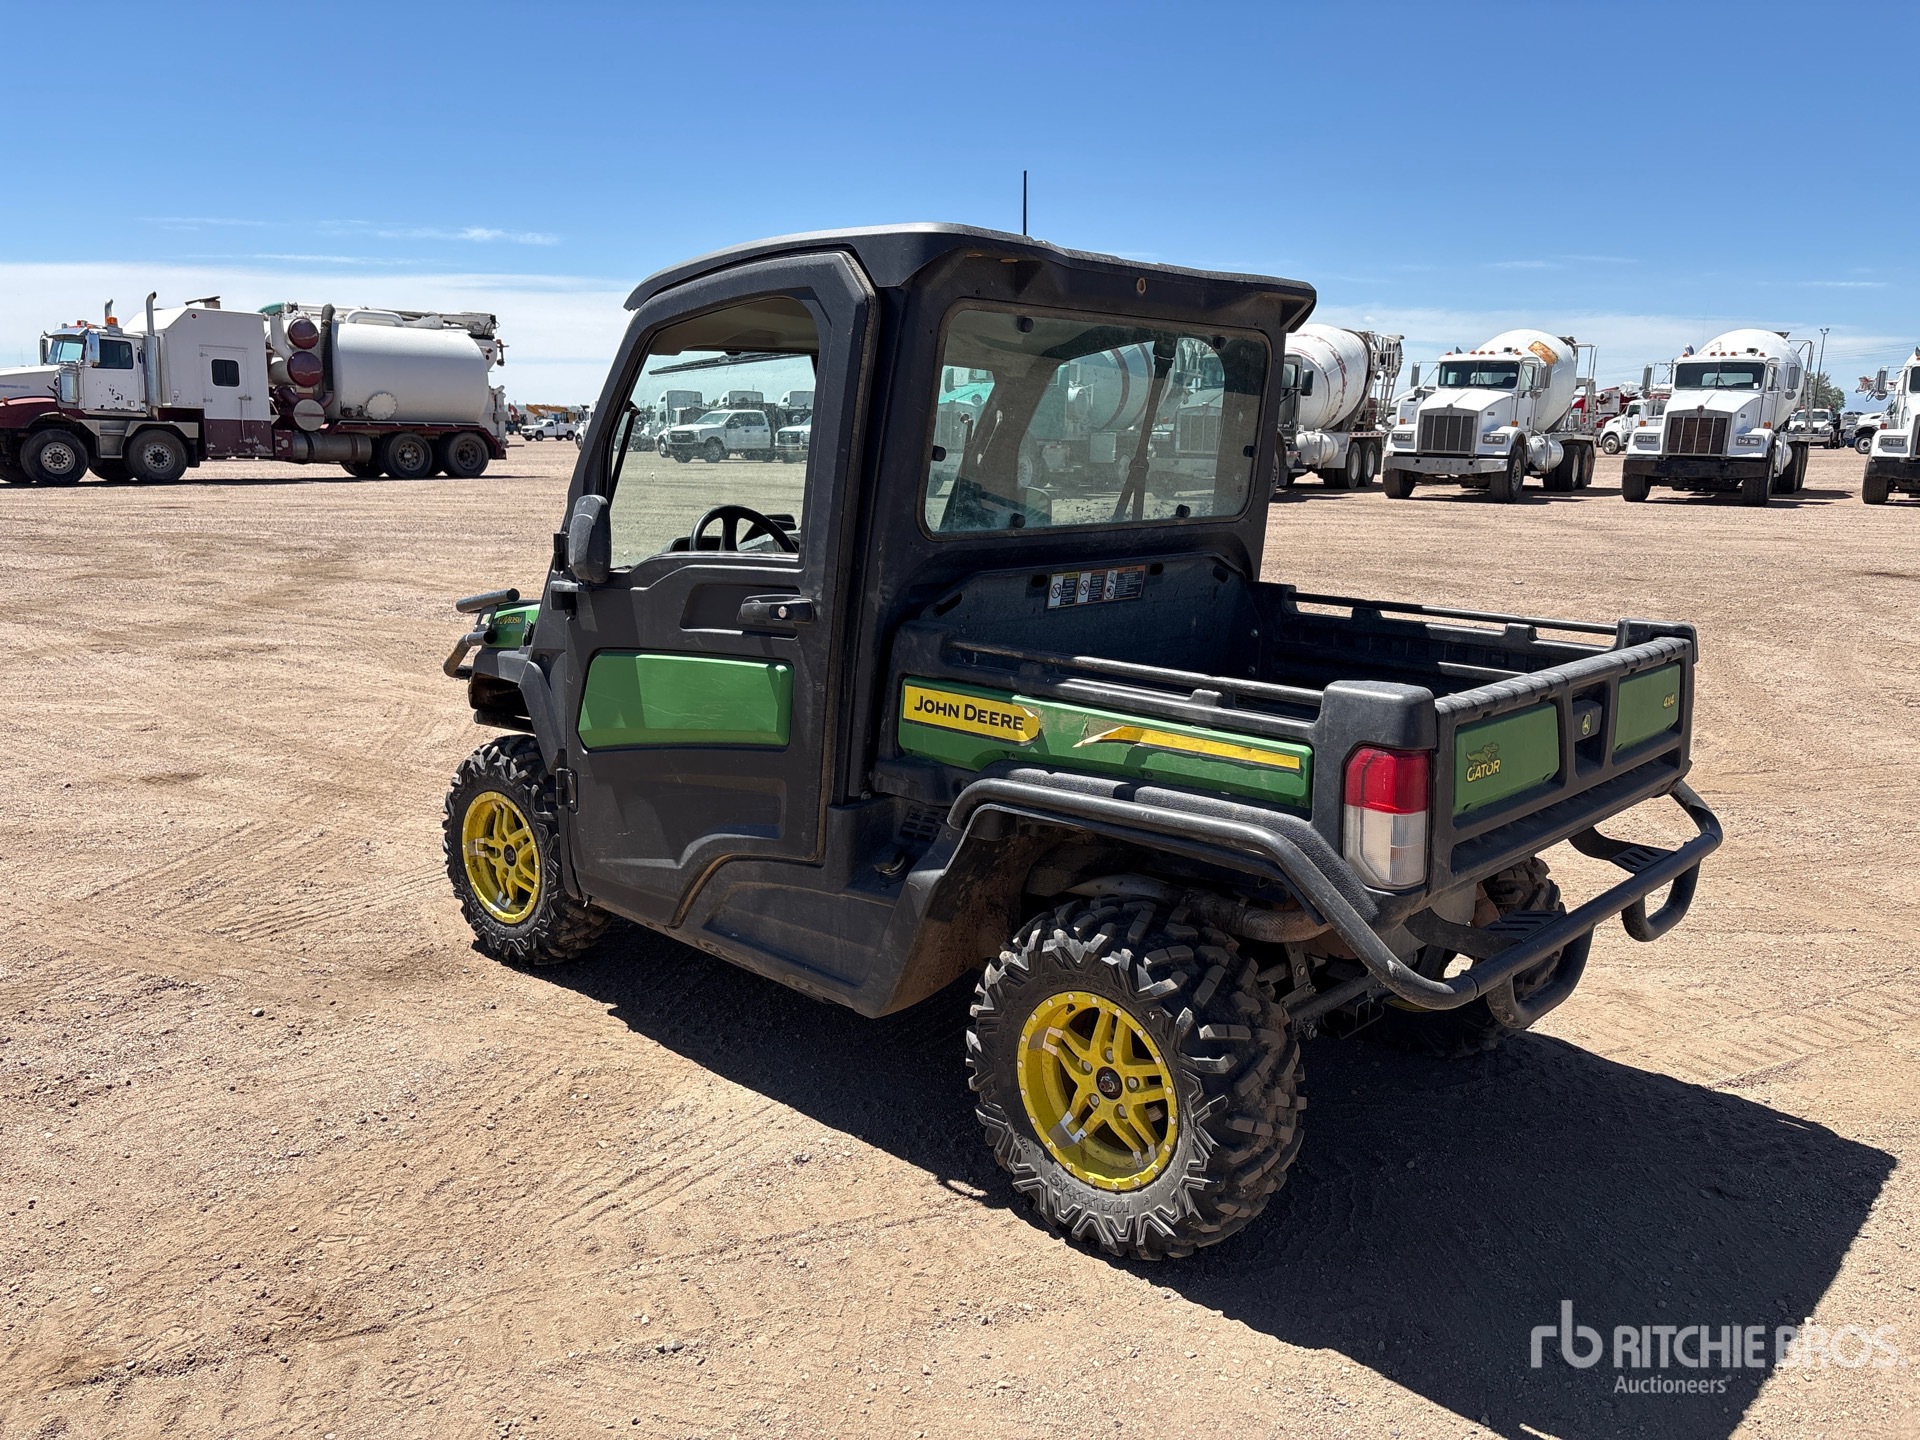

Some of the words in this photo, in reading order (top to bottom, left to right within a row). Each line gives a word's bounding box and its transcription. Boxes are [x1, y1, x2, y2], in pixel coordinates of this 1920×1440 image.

[914, 695, 960, 719] JOHN
[963, 703, 1025, 731] DEERE
[1466, 759, 1501, 782] GATOR
[1048, 1171, 1131, 1213] MAXXIS
